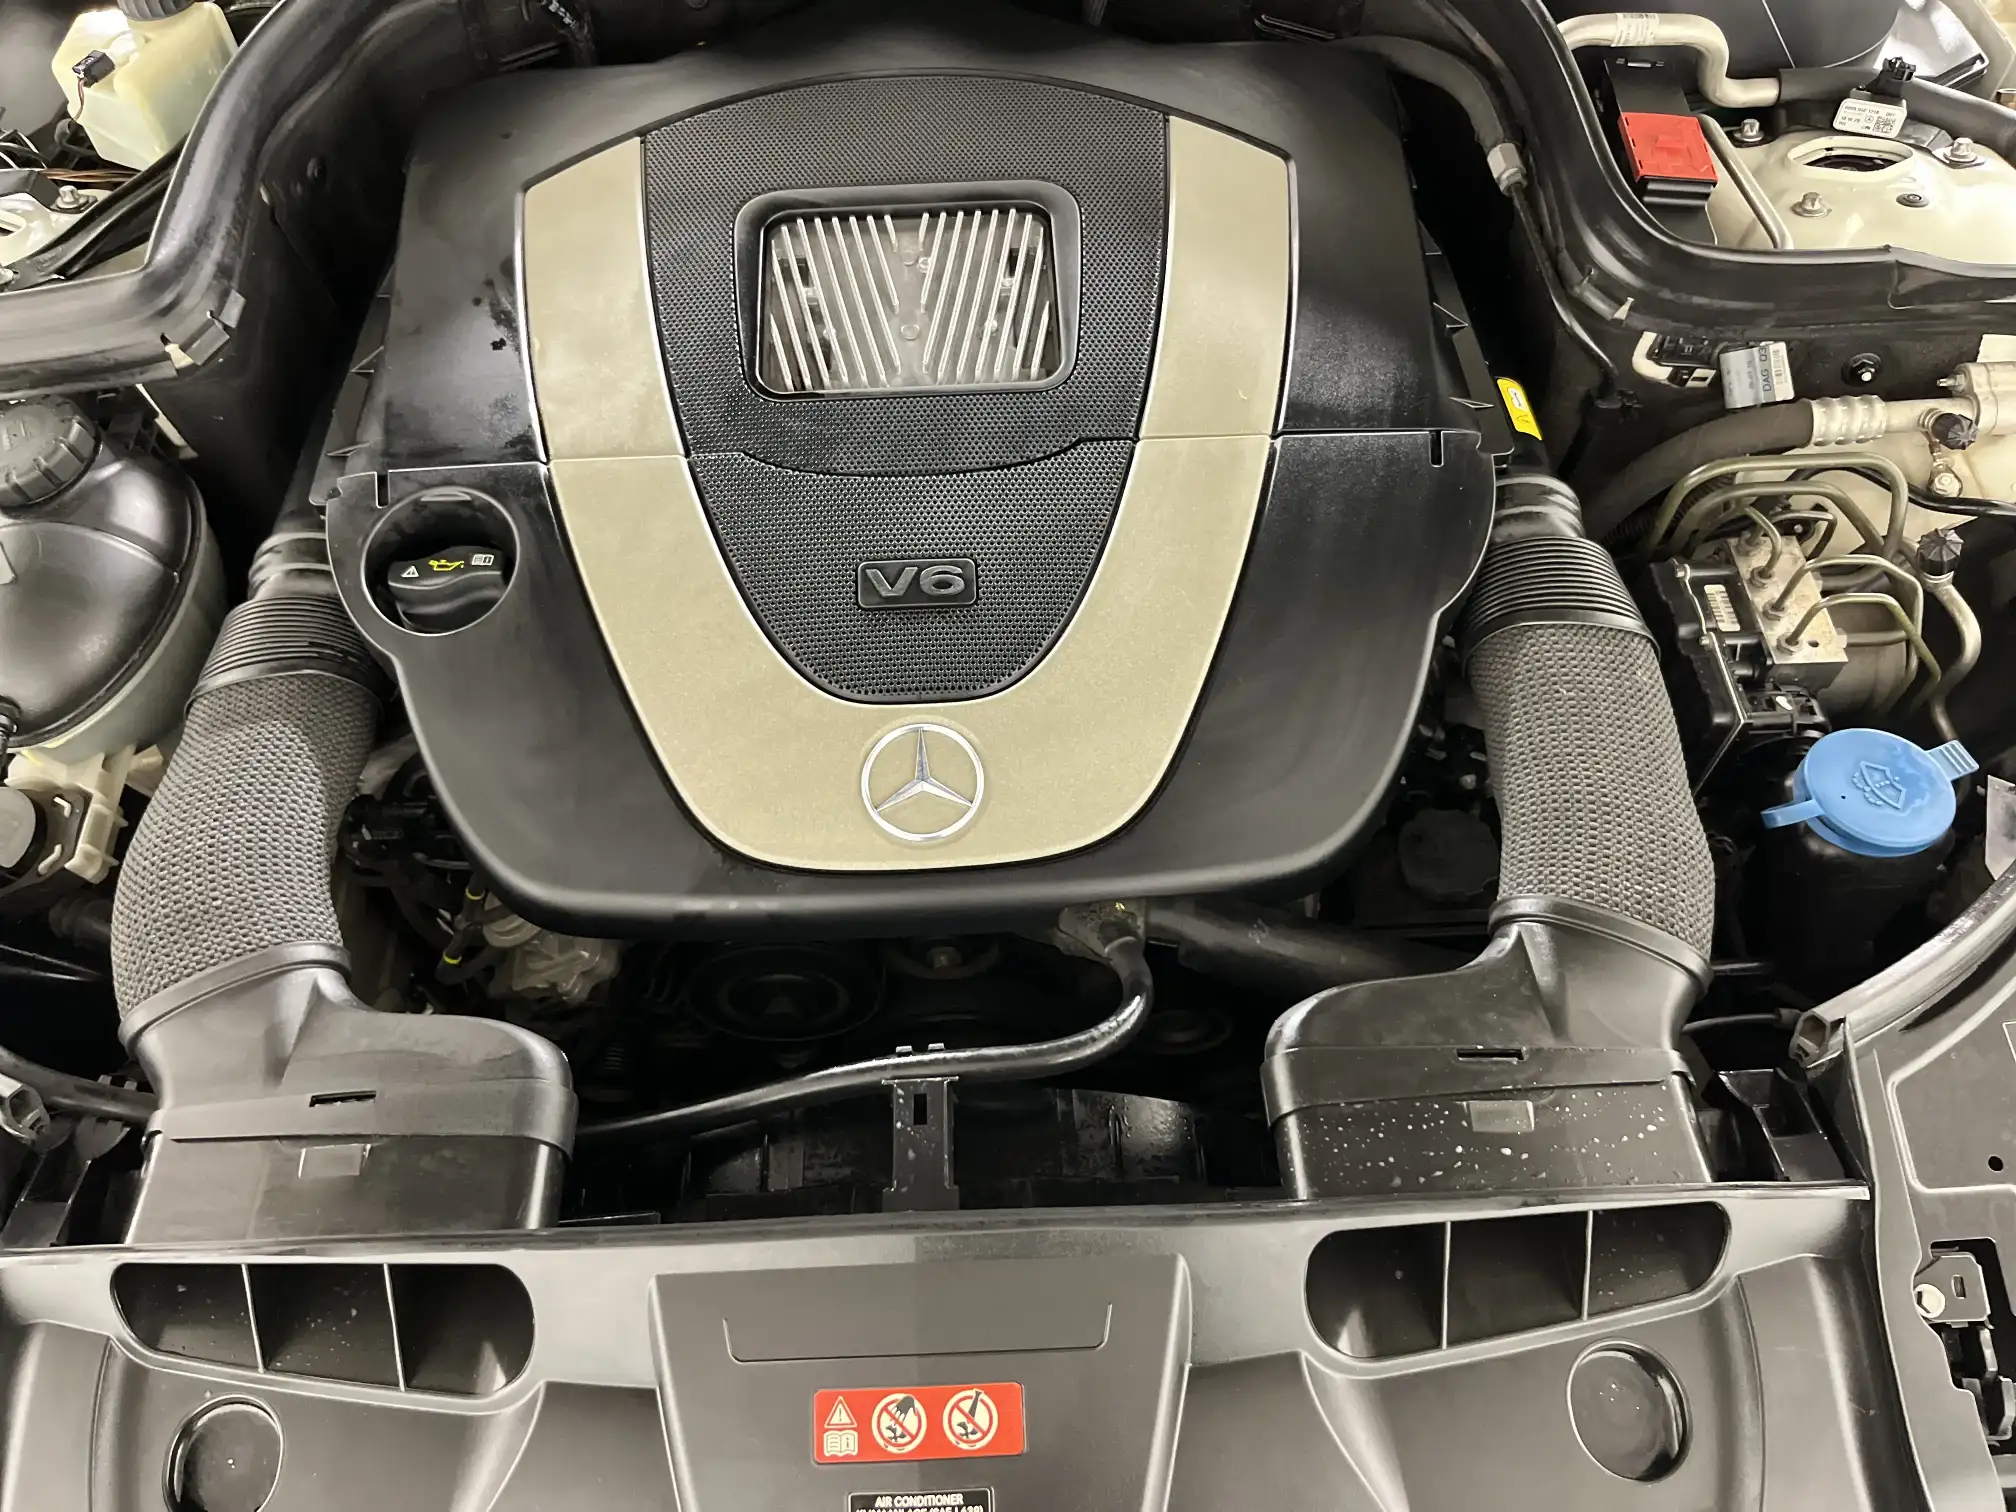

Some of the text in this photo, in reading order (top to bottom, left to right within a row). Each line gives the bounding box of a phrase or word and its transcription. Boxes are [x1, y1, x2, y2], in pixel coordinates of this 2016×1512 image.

[1761, 368, 1772, 392] DAG
[865, 564, 966, 598] V6
[874, 1492, 965, 1508] AIR CONDITIONER
